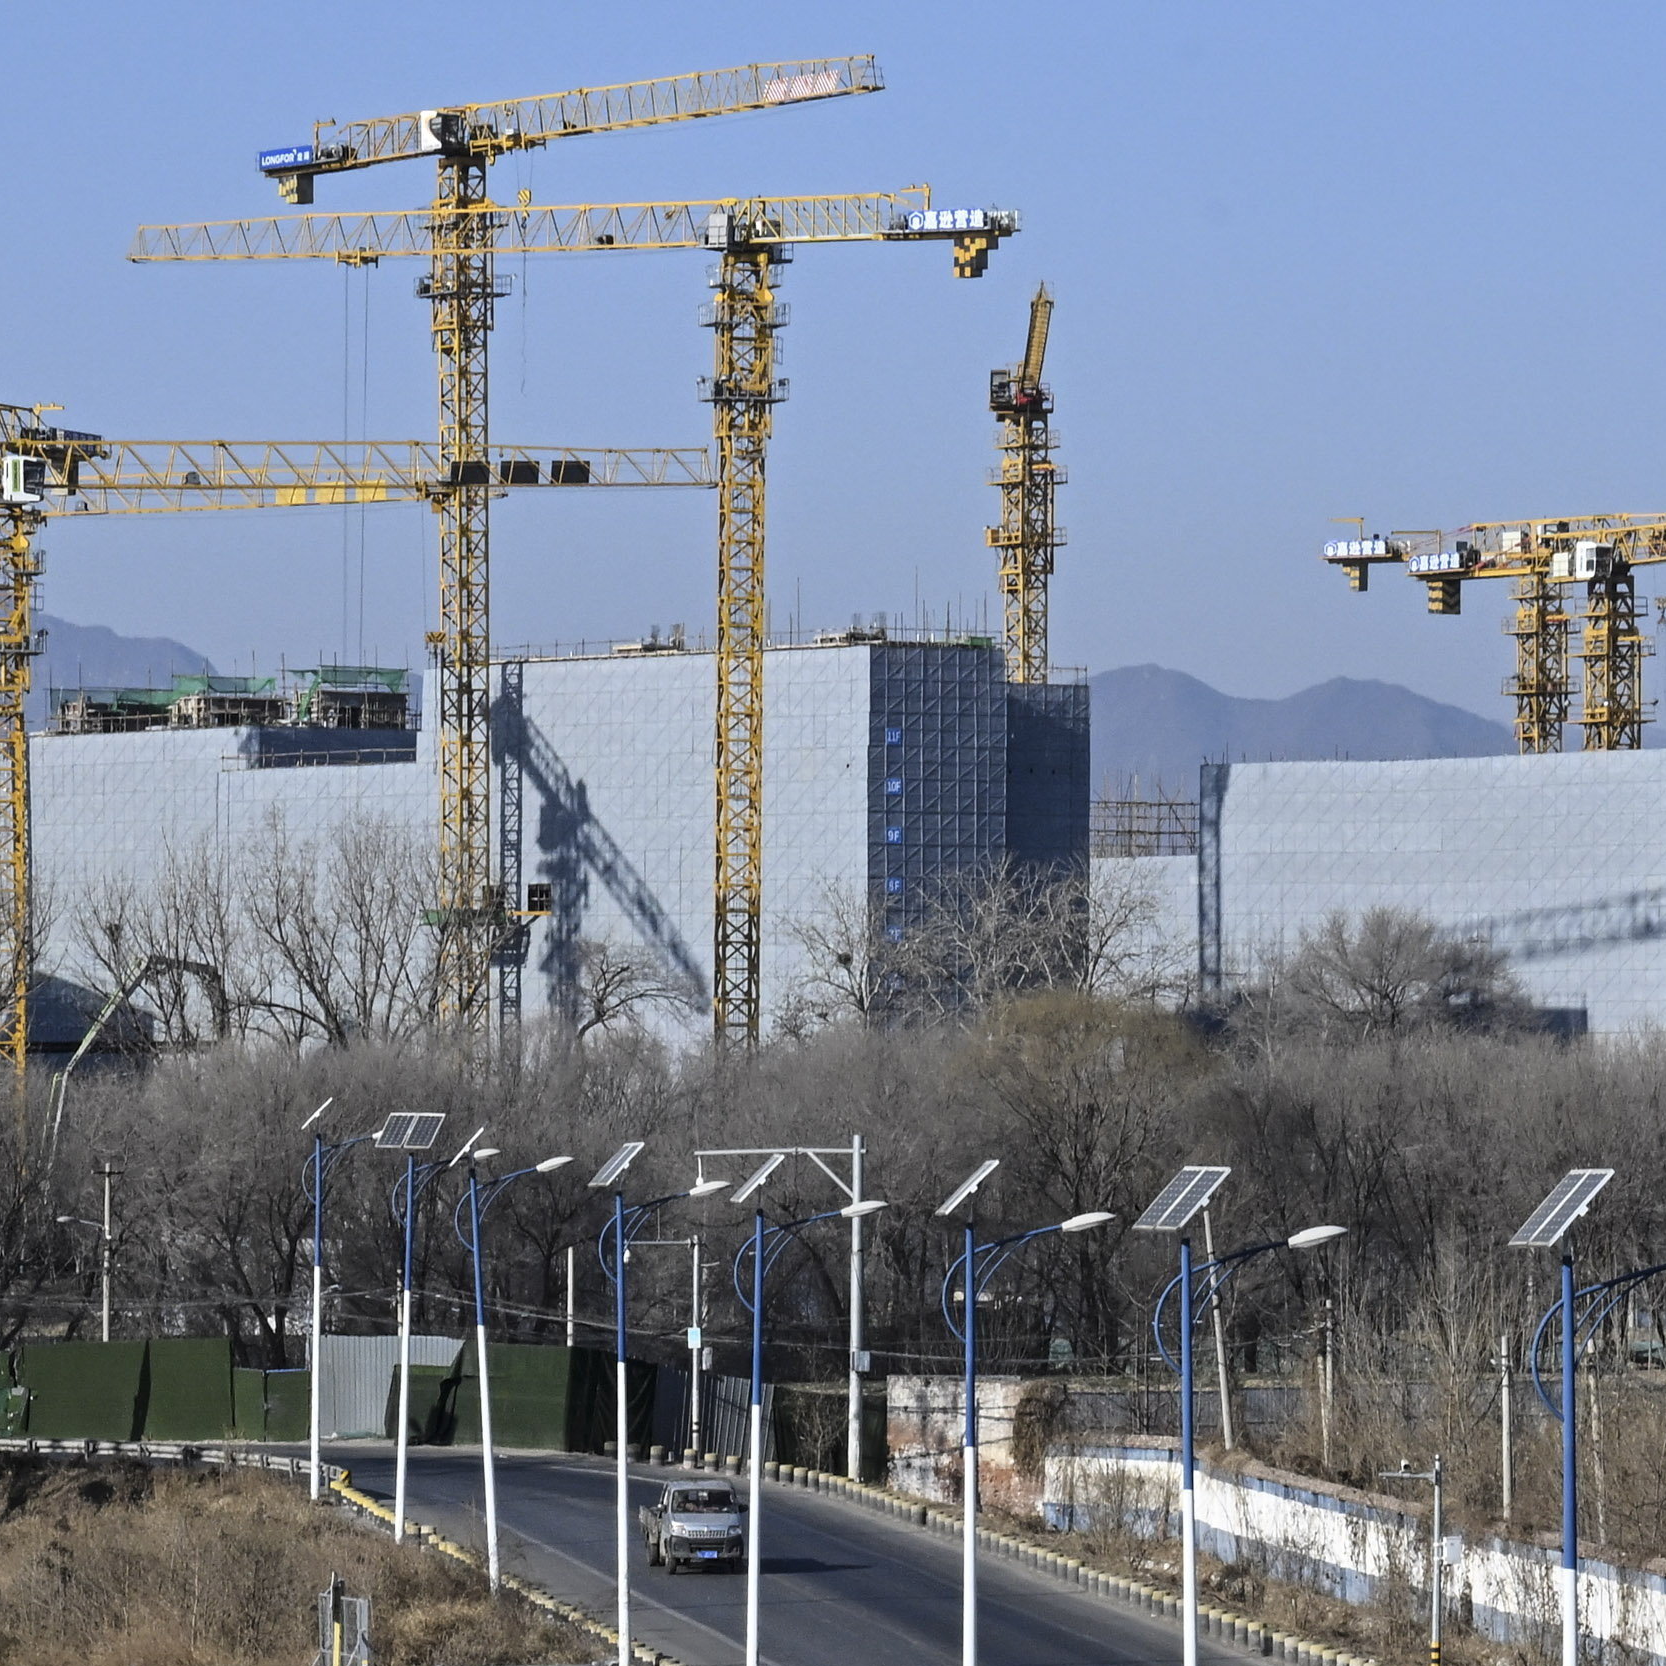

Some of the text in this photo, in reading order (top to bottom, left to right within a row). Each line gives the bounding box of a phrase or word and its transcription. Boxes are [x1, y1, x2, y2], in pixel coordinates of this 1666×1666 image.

[887, 731, 901, 743] 11F
[887, 781, 901, 792] 10F
[887, 830, 900, 842] 9F
